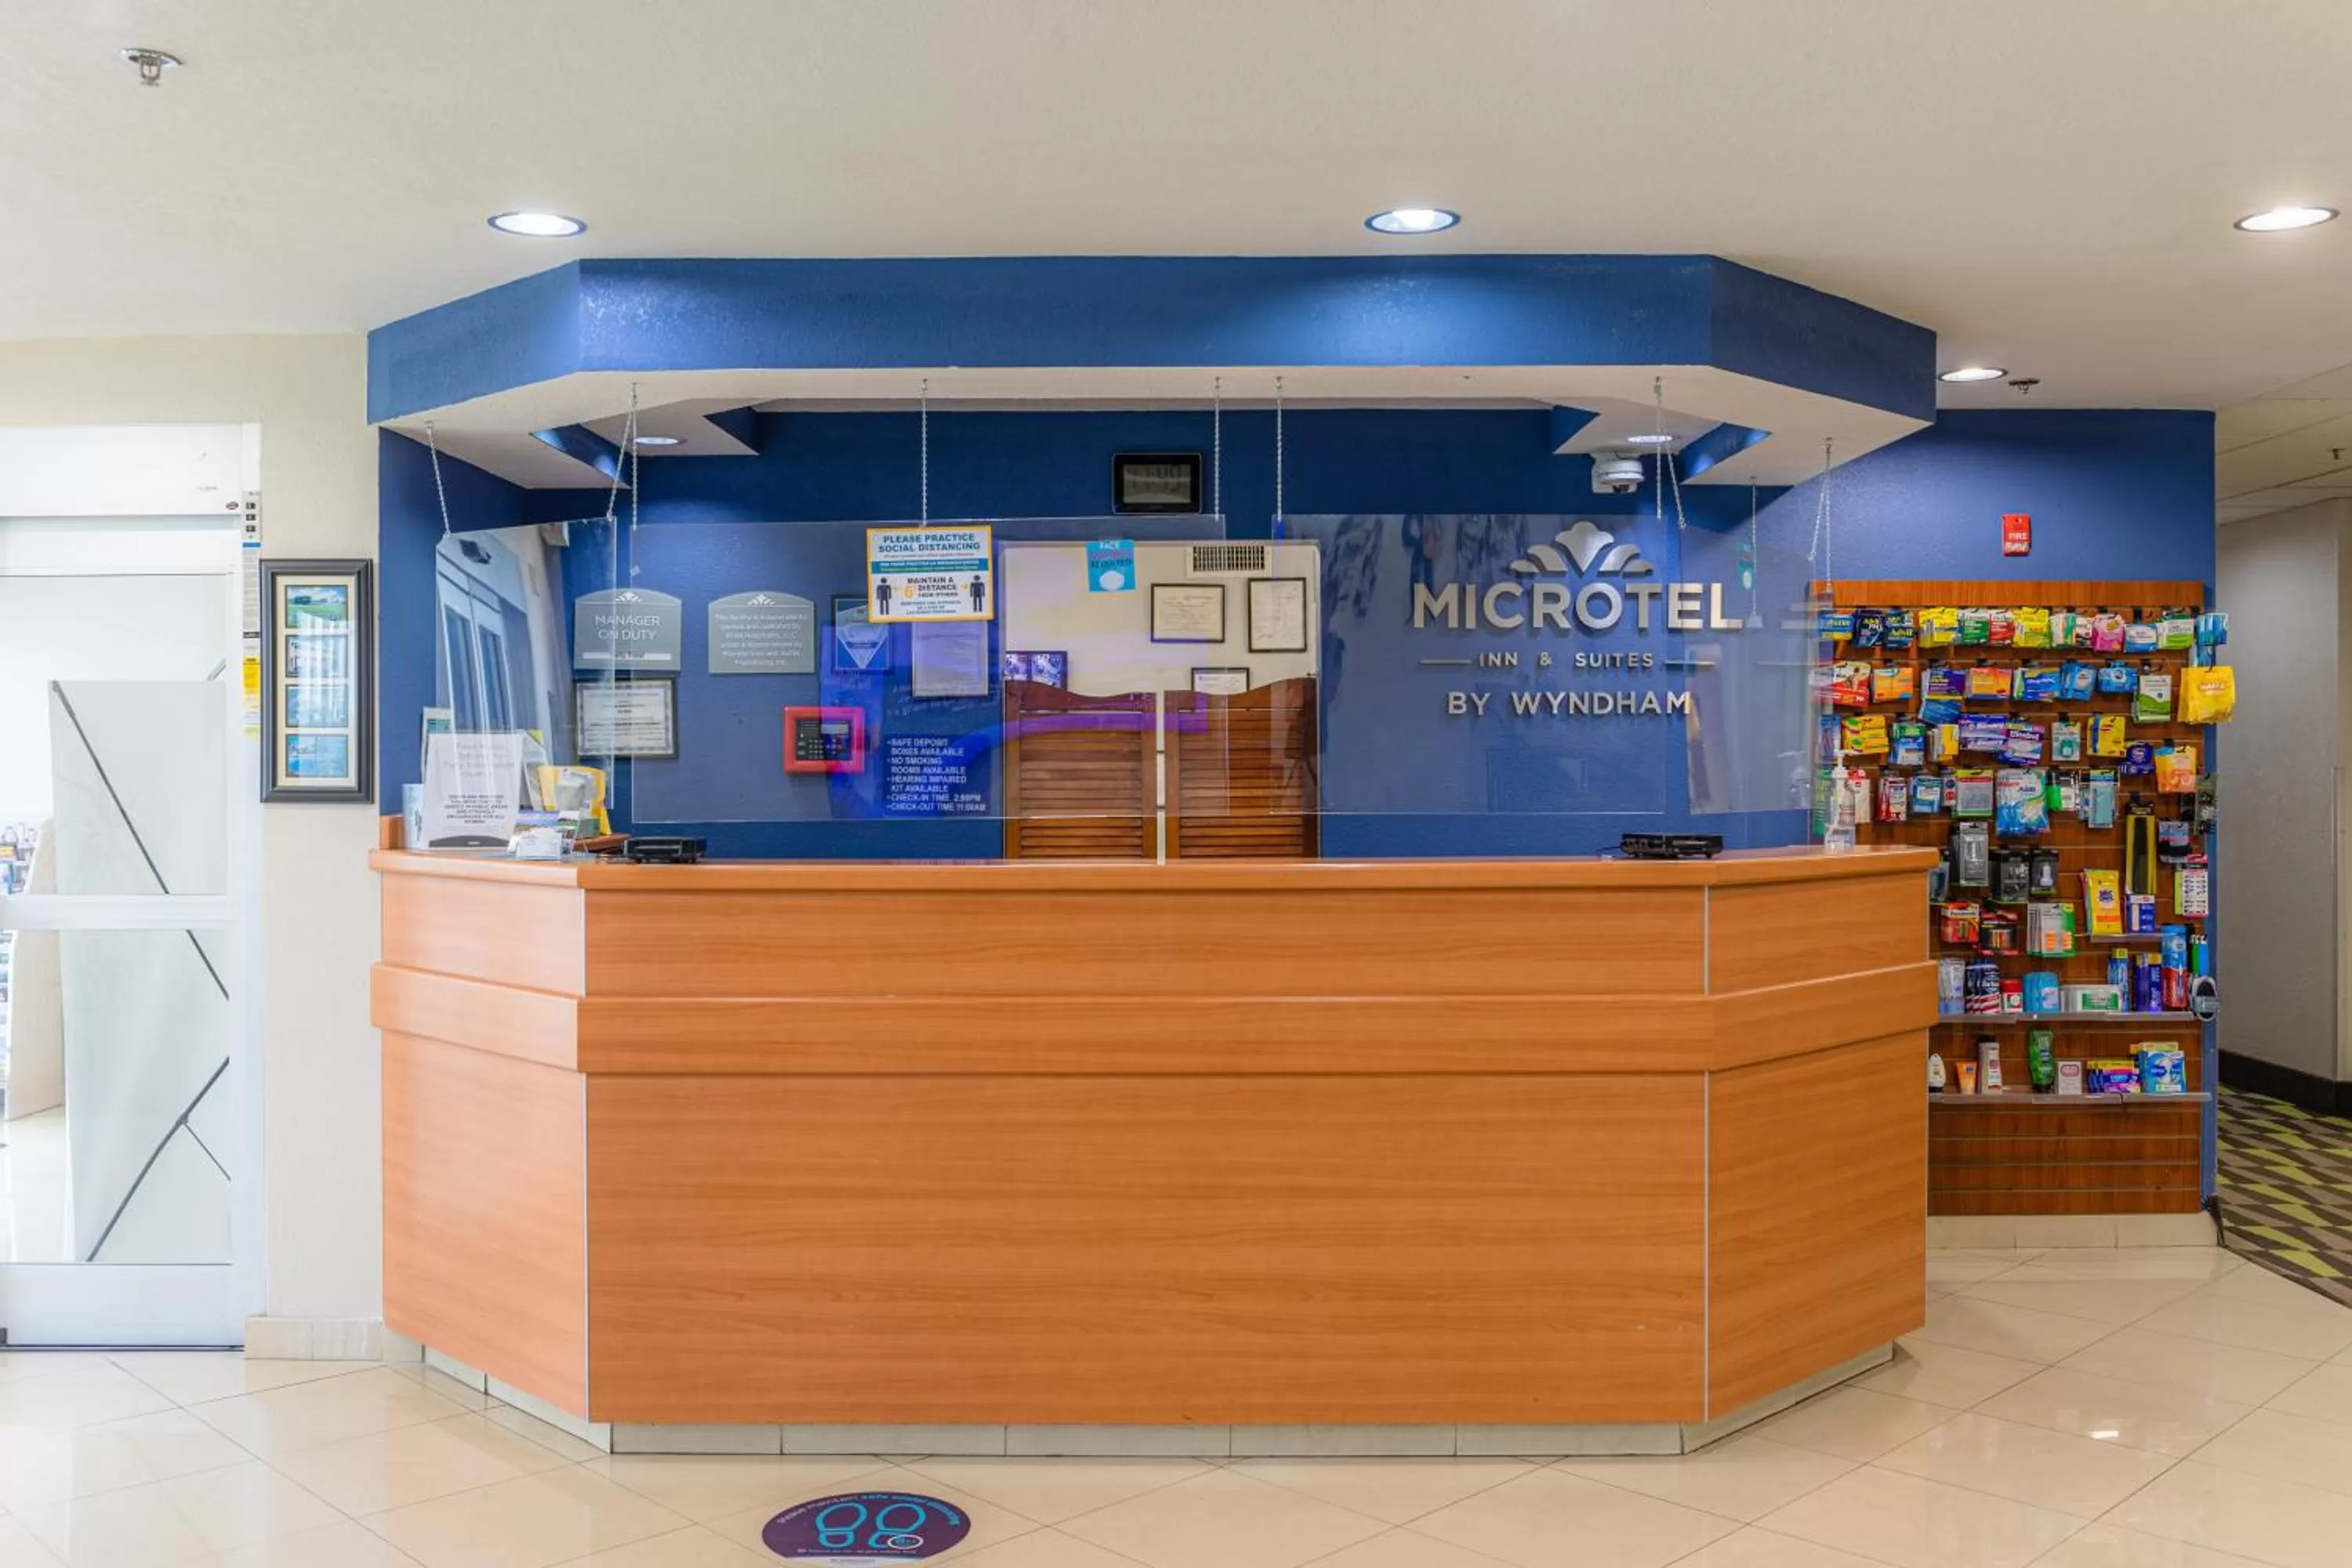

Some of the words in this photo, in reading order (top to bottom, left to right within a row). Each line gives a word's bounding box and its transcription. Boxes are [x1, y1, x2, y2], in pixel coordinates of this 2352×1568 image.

[883, 534, 921, 544] PLEASE
[924, 532, 975, 543] PRACTICE
[878, 543, 915, 553] SOCIAL
[918, 542, 981, 551] DISTANCING
[1414, 582, 1744, 629] MICROTEL
[595, 615, 661, 626] MANAGER
[598, 630, 619, 640] ON
[622, 630, 658, 641] DUTY
[1479, 652, 1519, 667] INN
[1539, 652, 1553, 666] &
[1575, 652, 1655, 668] SUITES
[1447, 691, 1491, 715] BY
[1512, 691, 1691, 716] WYNDHAM
[913, 739, 948, 747] DEPOSIT
[891, 747, 919, 756] BOXES
[920, 747, 965, 757] AVAILABLE
[891, 757, 904, 765] NO
[906, 757, 942, 765] SMOKING
[921, 766, 967, 775] AVAILABLE
[905, 784, 949, 793] AVAILABLE
[891, 802, 935, 811] CHECK-OUT
[937, 803, 955, 811] TIME
